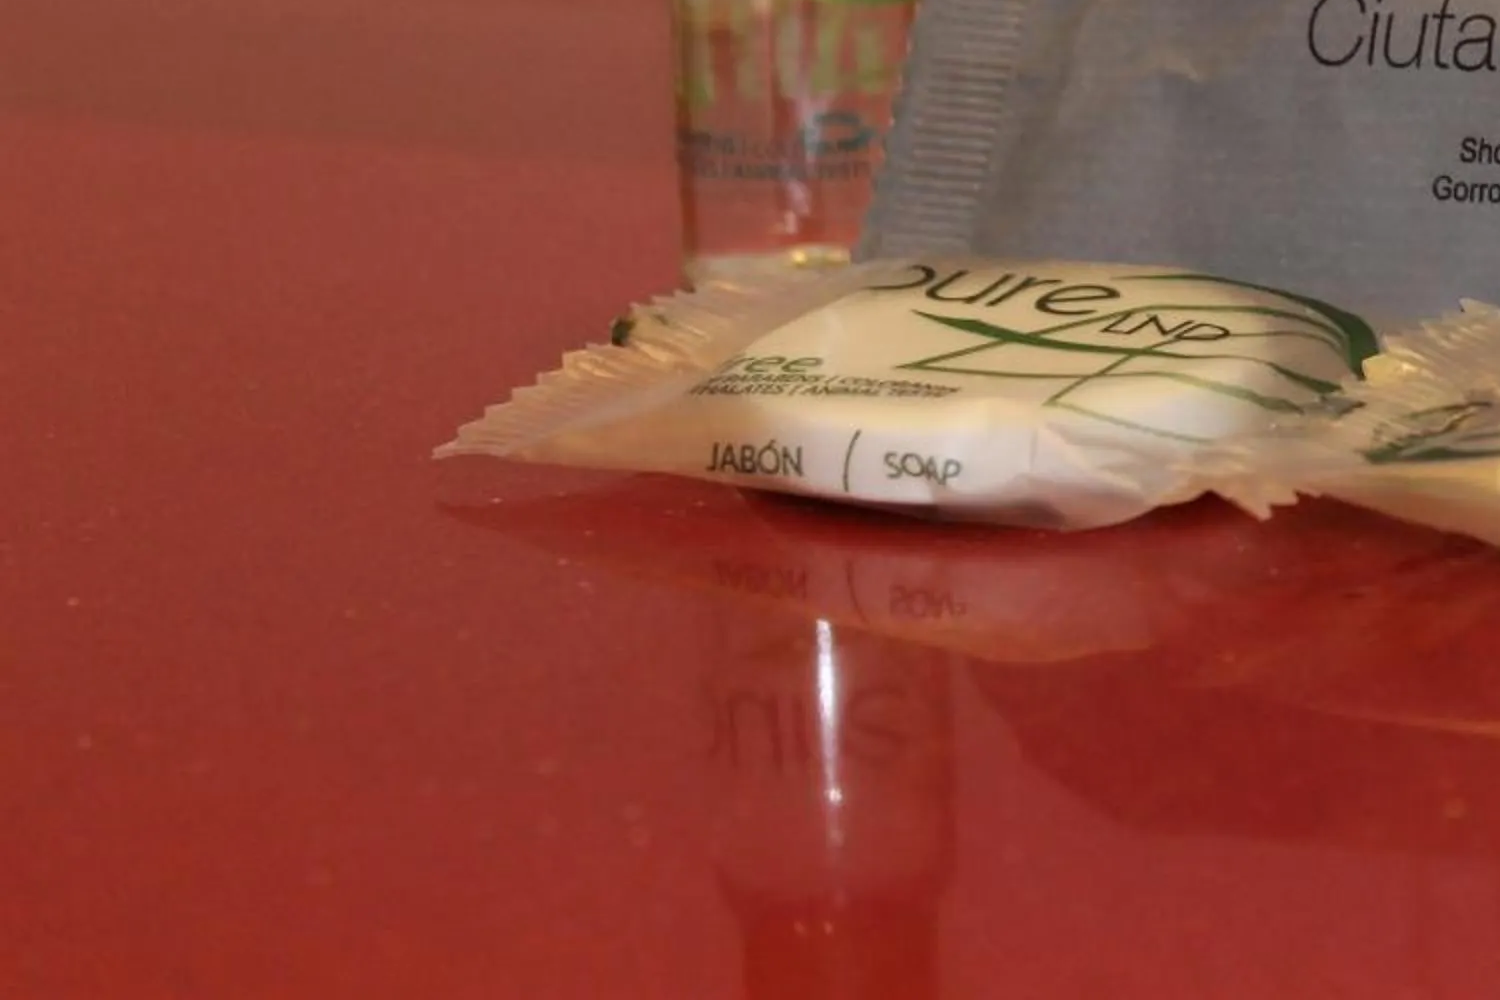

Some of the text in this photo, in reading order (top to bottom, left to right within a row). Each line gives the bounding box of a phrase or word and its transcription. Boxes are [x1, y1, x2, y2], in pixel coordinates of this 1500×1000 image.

[1099, 313, 1231, 342] LND
[705, 439, 962, 486] JABÓN SOAP
